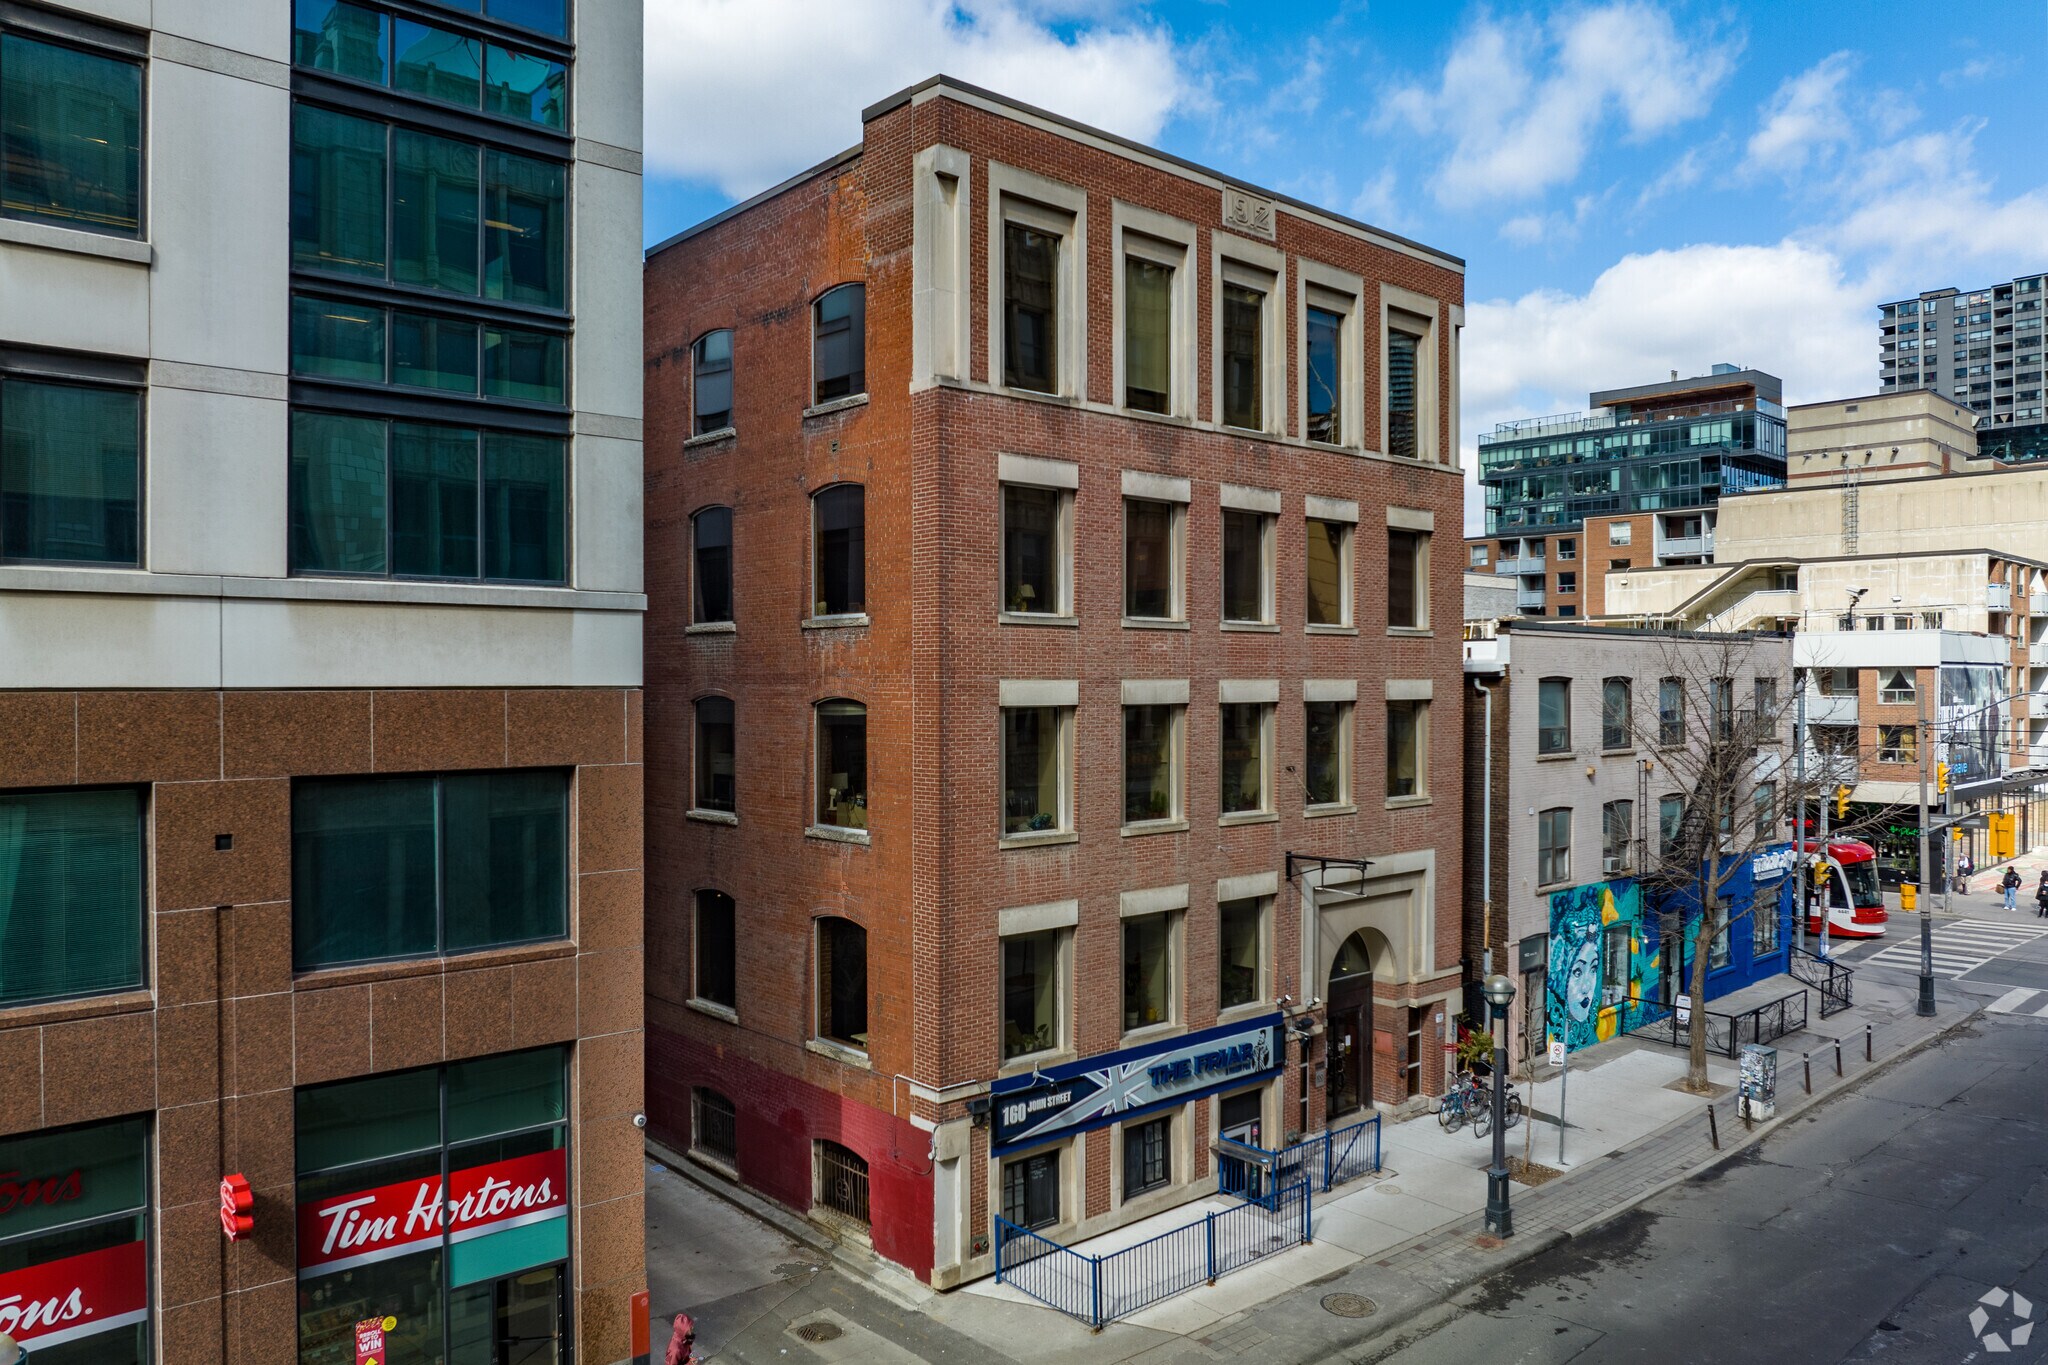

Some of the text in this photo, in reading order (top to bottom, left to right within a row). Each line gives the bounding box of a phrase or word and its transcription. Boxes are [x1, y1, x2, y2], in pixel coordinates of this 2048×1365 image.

[1147, 1058, 1192, 1088] THE
[1194, 1043, 1253, 1076] FRIAR
[1002, 1091, 1072, 1126] 160 JOHN STREET
[0, 1169, 82, 1214] ons
[318, 1195, 397, 1255] Tim
[0, 1287, 94, 1336] ons.
[358, 1338, 382, 1353] WIN
